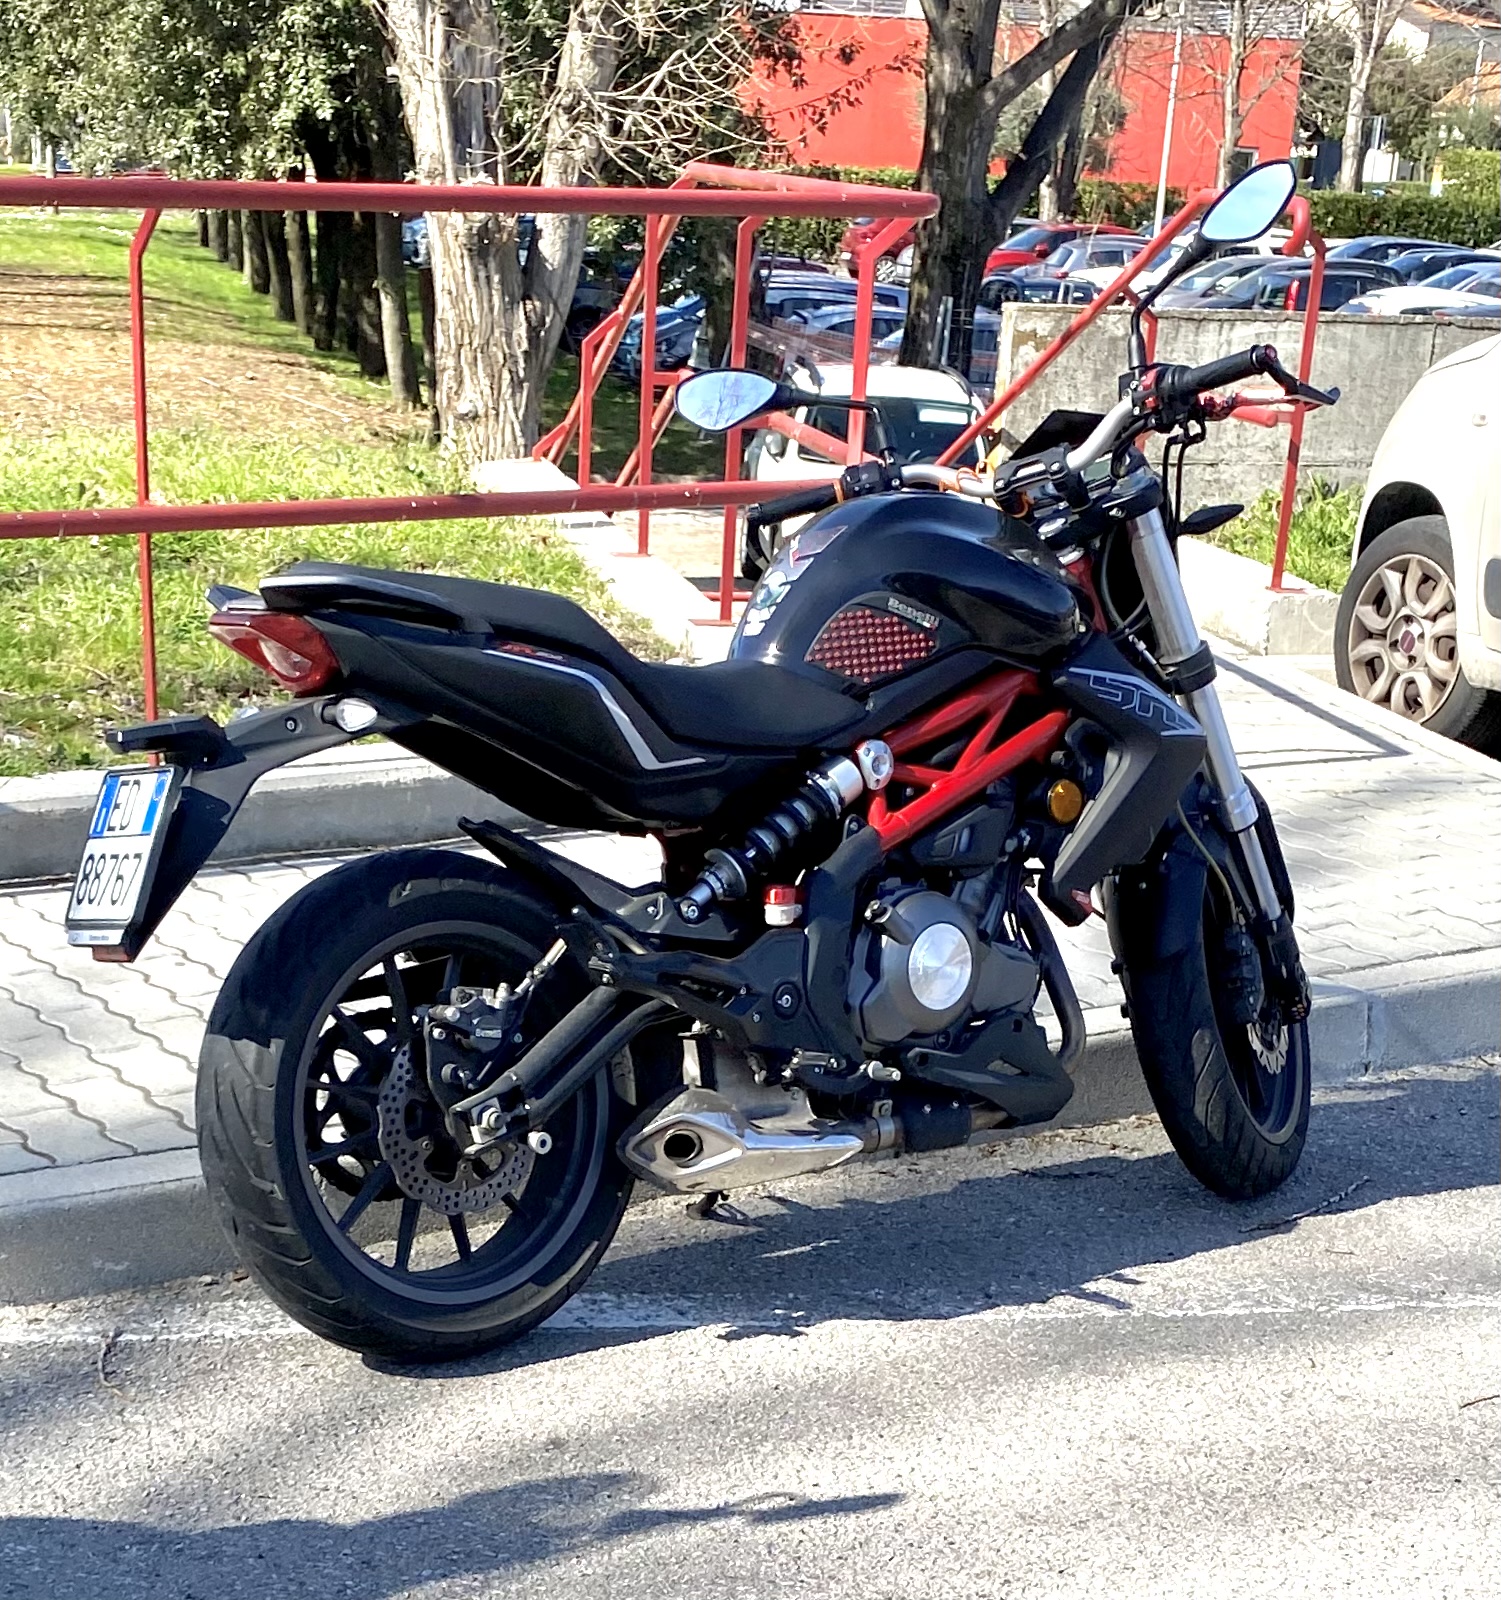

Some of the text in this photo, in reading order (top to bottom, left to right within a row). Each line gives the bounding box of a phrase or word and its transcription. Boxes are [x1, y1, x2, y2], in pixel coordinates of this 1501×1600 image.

[888, 597, 940, 628] Benelli
[106, 779, 141, 832] ED
[76, 853, 143, 906] 88767
